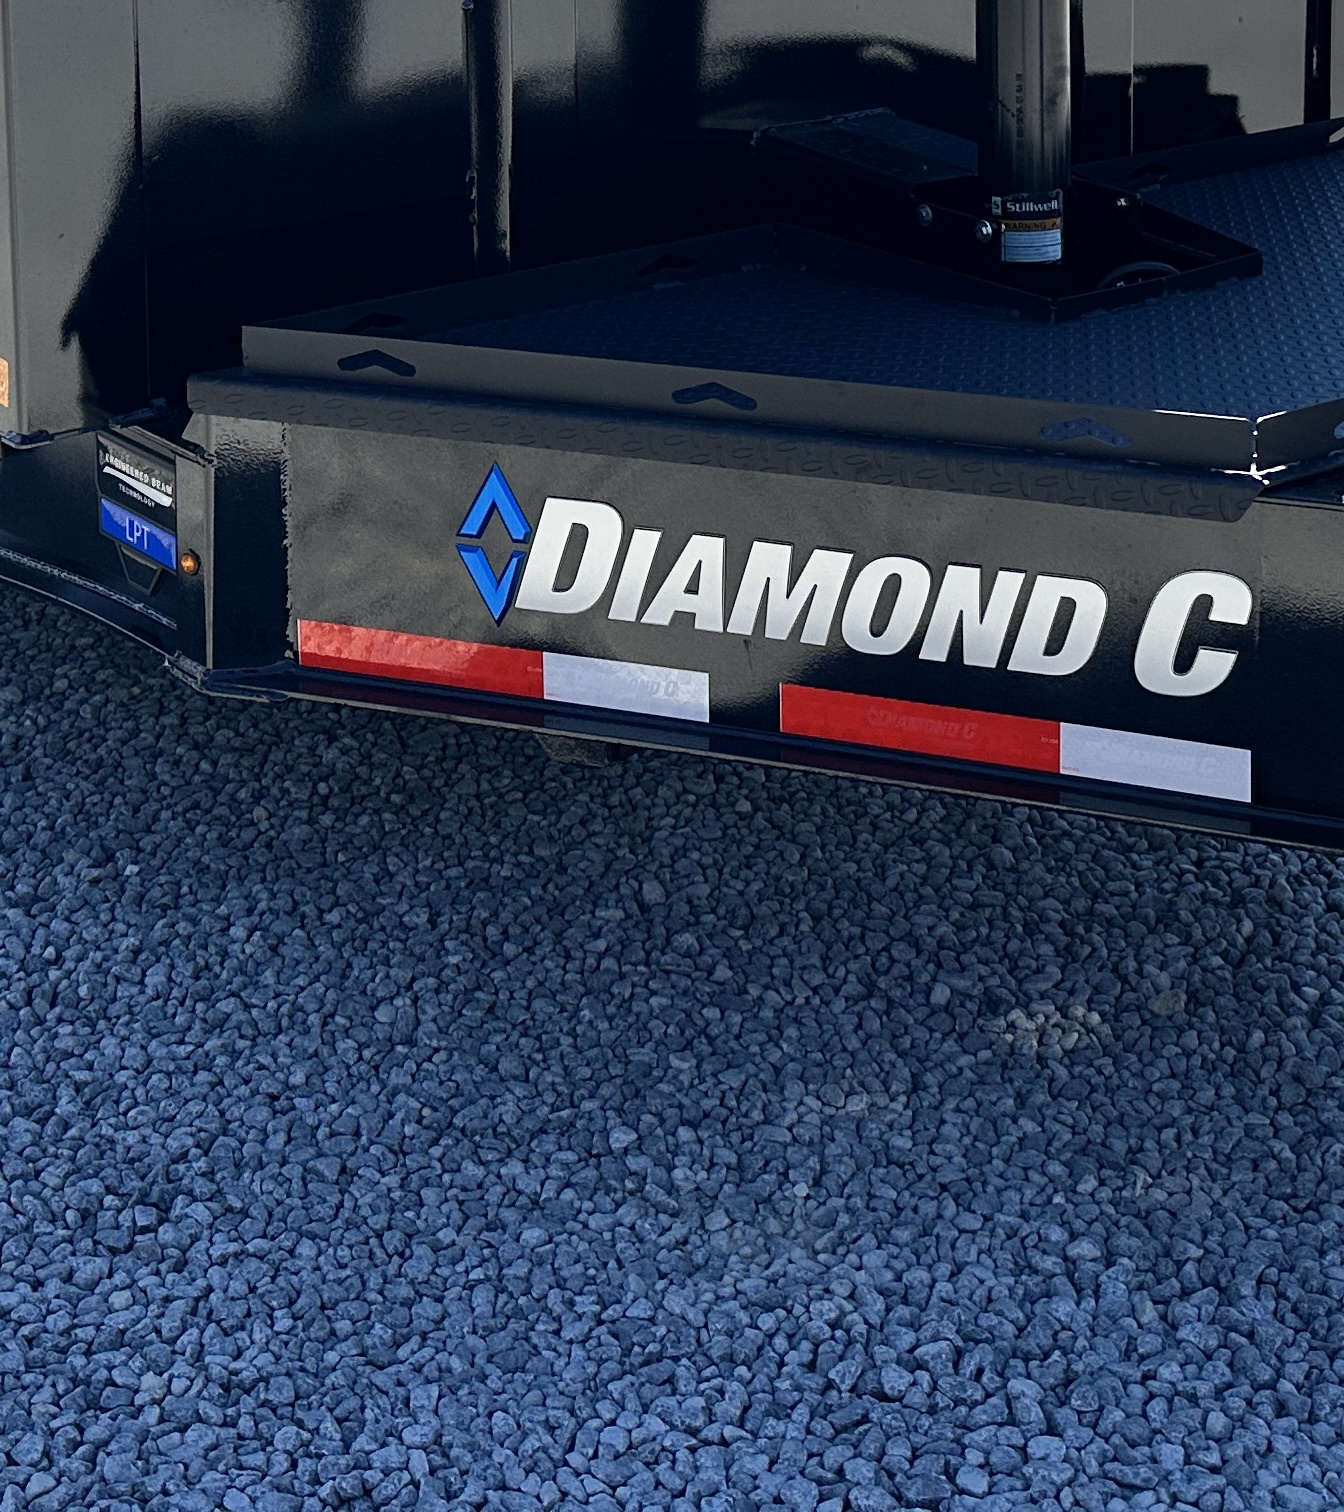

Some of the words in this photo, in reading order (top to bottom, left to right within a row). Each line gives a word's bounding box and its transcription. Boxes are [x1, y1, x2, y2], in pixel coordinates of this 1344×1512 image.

[1006, 199, 1058, 213] Stillwell
[1004, 221, 1047, 231] WARNING
[118, 482, 156, 508] TECHNOLOGY
[125, 517, 151, 550] LPT
[515, 496, 1108, 676] DIAMOND
[1133, 568, 1254, 698] C
